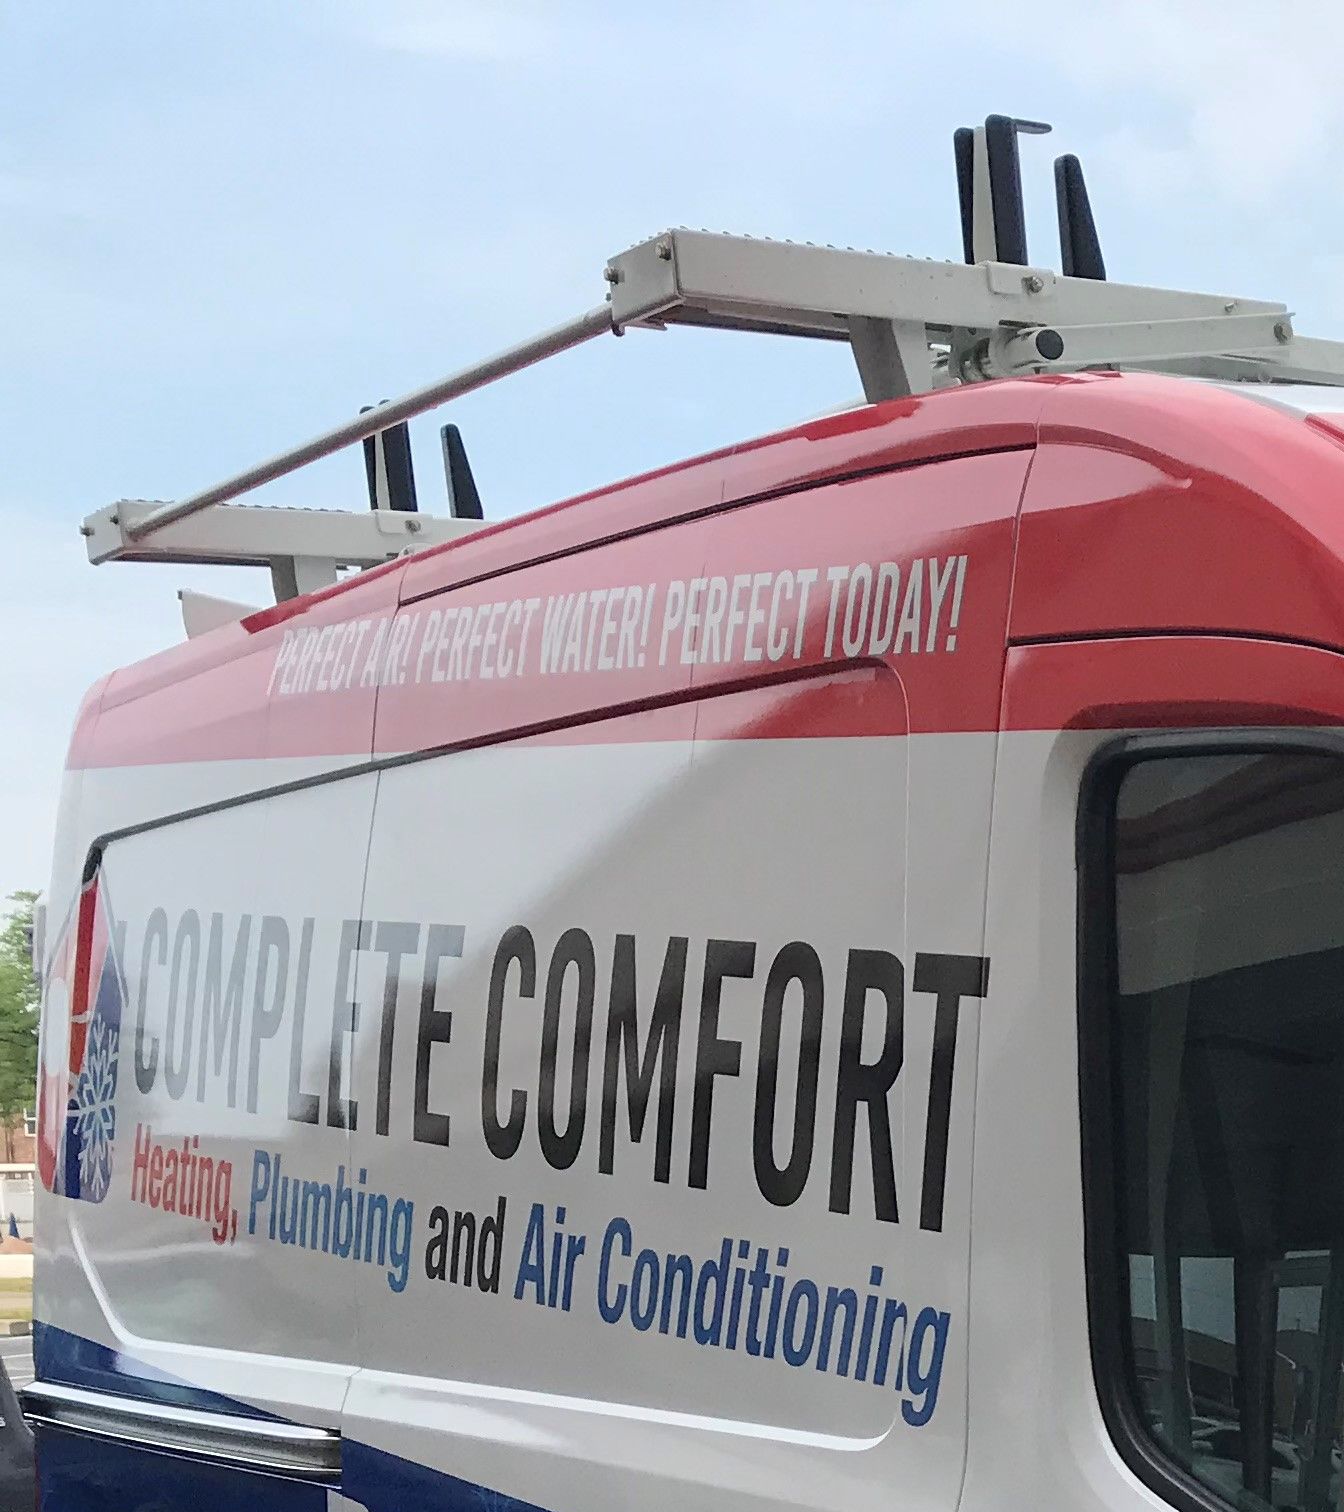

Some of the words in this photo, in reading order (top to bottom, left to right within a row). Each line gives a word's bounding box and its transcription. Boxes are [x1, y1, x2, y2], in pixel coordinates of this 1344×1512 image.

[266, 617, 373, 696] PERFECT
[359, 612, 421, 688] AIR!
[415, 598, 541, 684] PERFECT
[539, 582, 656, 674] WATER!
[658, 568, 819, 666] PERFECT
[823, 555, 968, 658] TODAY!
[133, 906, 467, 1147] COMPLETE
[480, 924, 991, 1233] COMFORT
[131, 1122, 239, 1248] Heating,
[248, 1151, 415, 1293] Plumbing
[425, 1196, 506, 1295] and
[513, 1201, 588, 1313] Air
[596, 1217, 953, 1428] Conditioning
